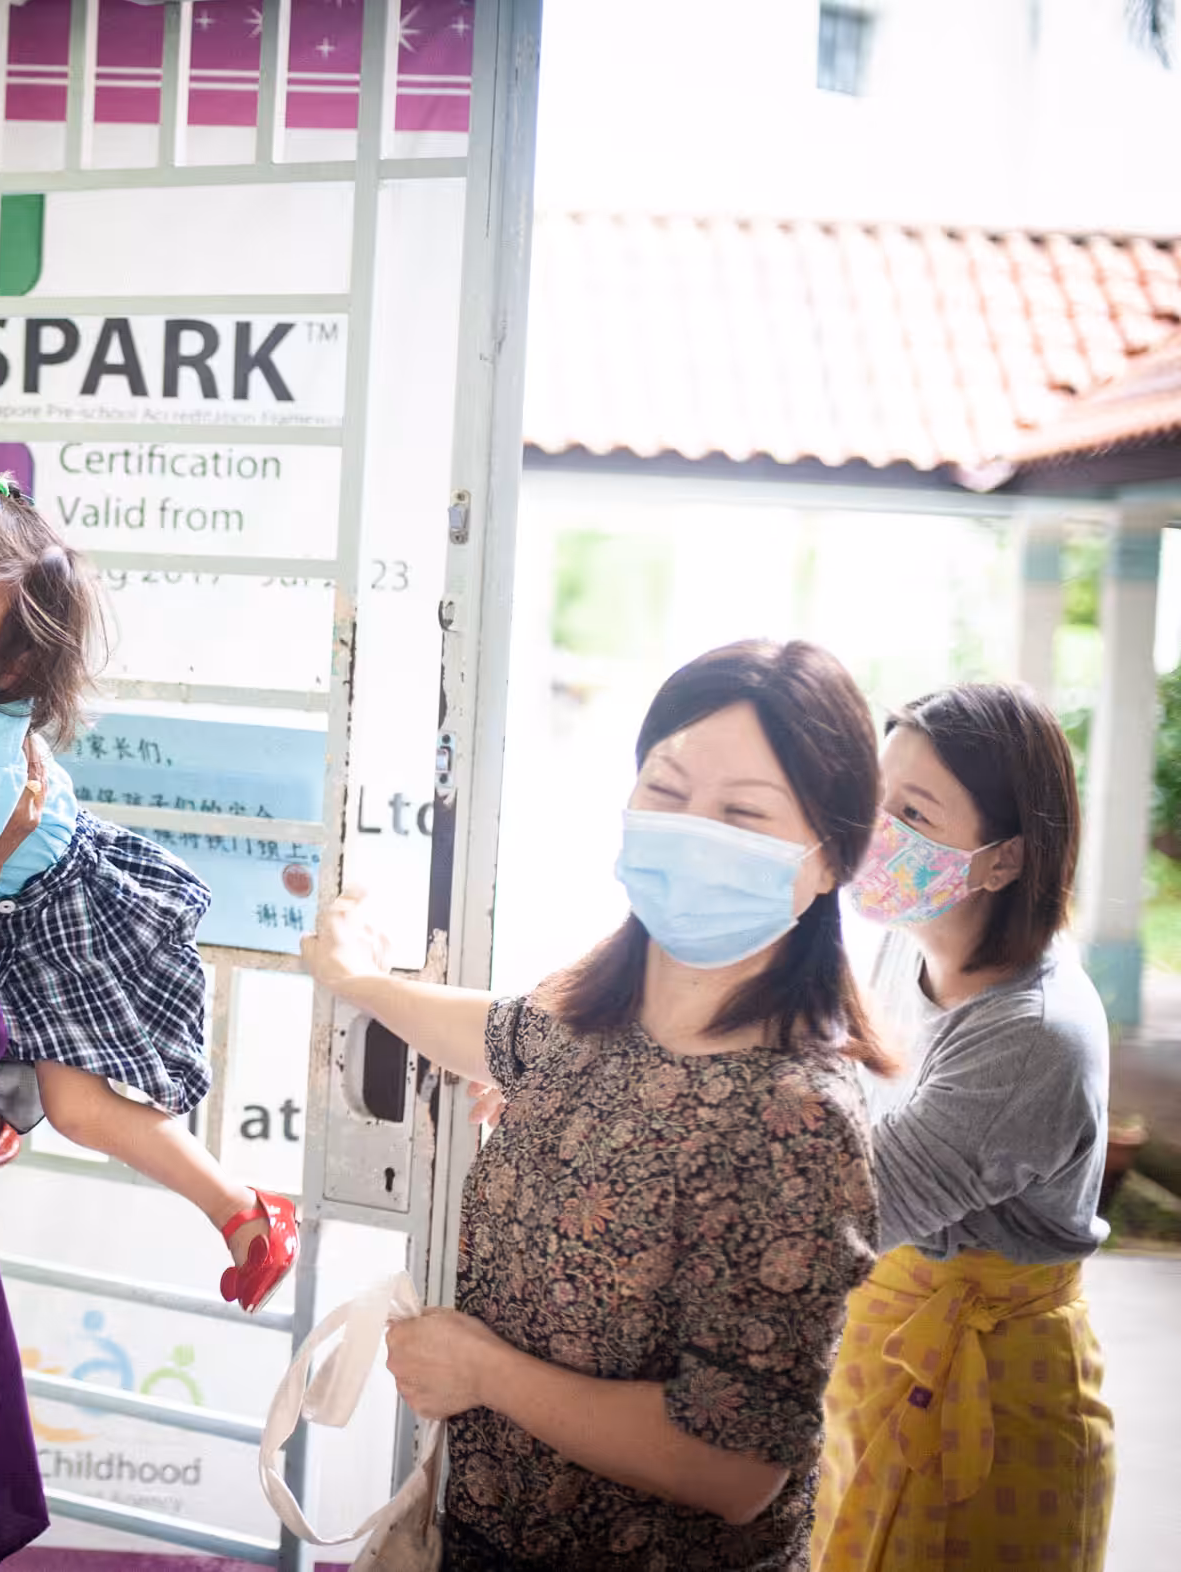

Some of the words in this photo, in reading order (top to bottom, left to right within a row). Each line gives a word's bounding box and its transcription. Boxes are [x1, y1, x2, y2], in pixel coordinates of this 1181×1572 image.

[59, 442, 282, 480] Certification
[57, 496, 146, 530] Valid
[159, 497, 244, 533] from
